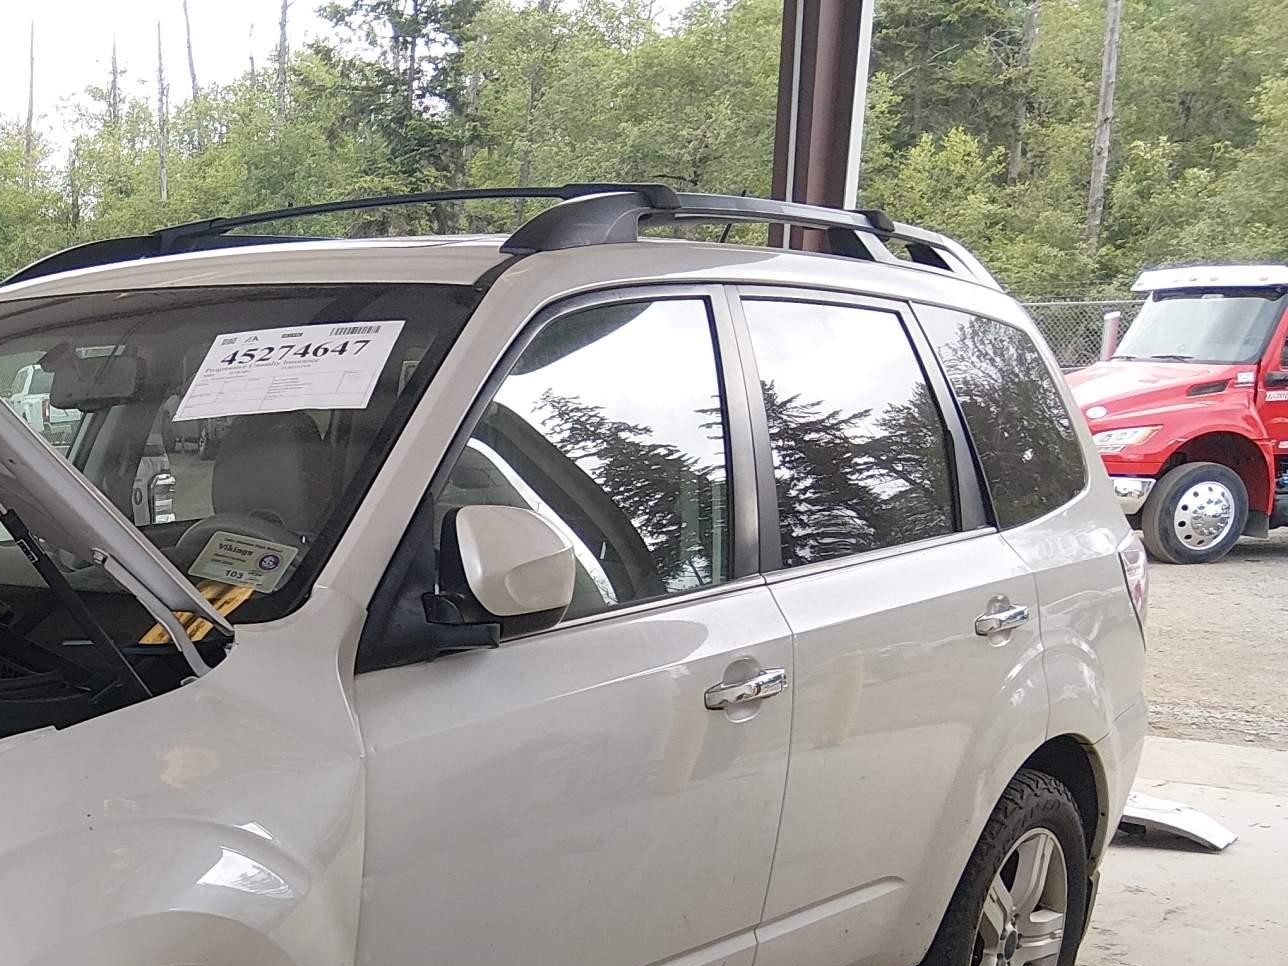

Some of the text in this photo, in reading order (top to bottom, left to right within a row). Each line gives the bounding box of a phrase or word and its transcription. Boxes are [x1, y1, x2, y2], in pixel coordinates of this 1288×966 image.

[220, 340, 372, 365] 45274647
[218, 543, 254, 557] Vikings
[225, 569, 244, 579] 103
